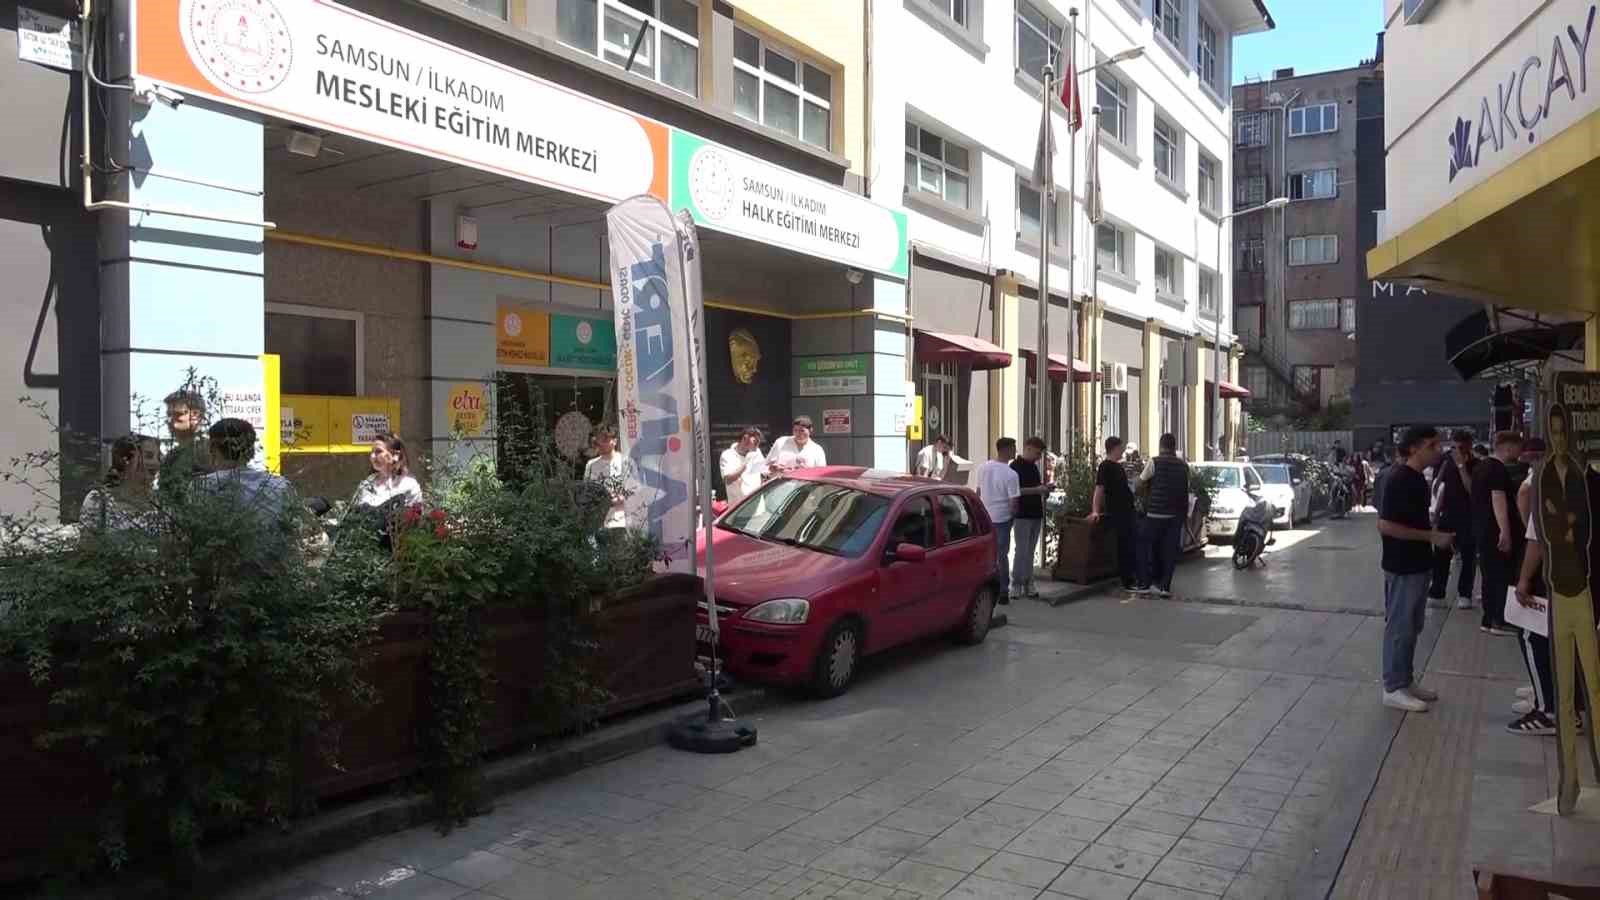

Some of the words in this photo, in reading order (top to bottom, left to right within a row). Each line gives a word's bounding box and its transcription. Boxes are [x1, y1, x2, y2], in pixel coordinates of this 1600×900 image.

[316, 34, 410, 82] SAMSUN
[428, 66, 505, 112] İLKADIM
[1474, 5, 1596, 167] AKÇAY
[316, 70, 428, 124] MESLEKİ
[435, 105, 510, 148] EĞİTİM
[516, 131, 598, 174] MERKEZİ
[742, 200, 774, 225] HALK
[777, 211, 818, 236] EĞİTİMİ
[819, 224, 861, 249] MERKEZİ
[743, 177, 784, 202] SAMSUN
